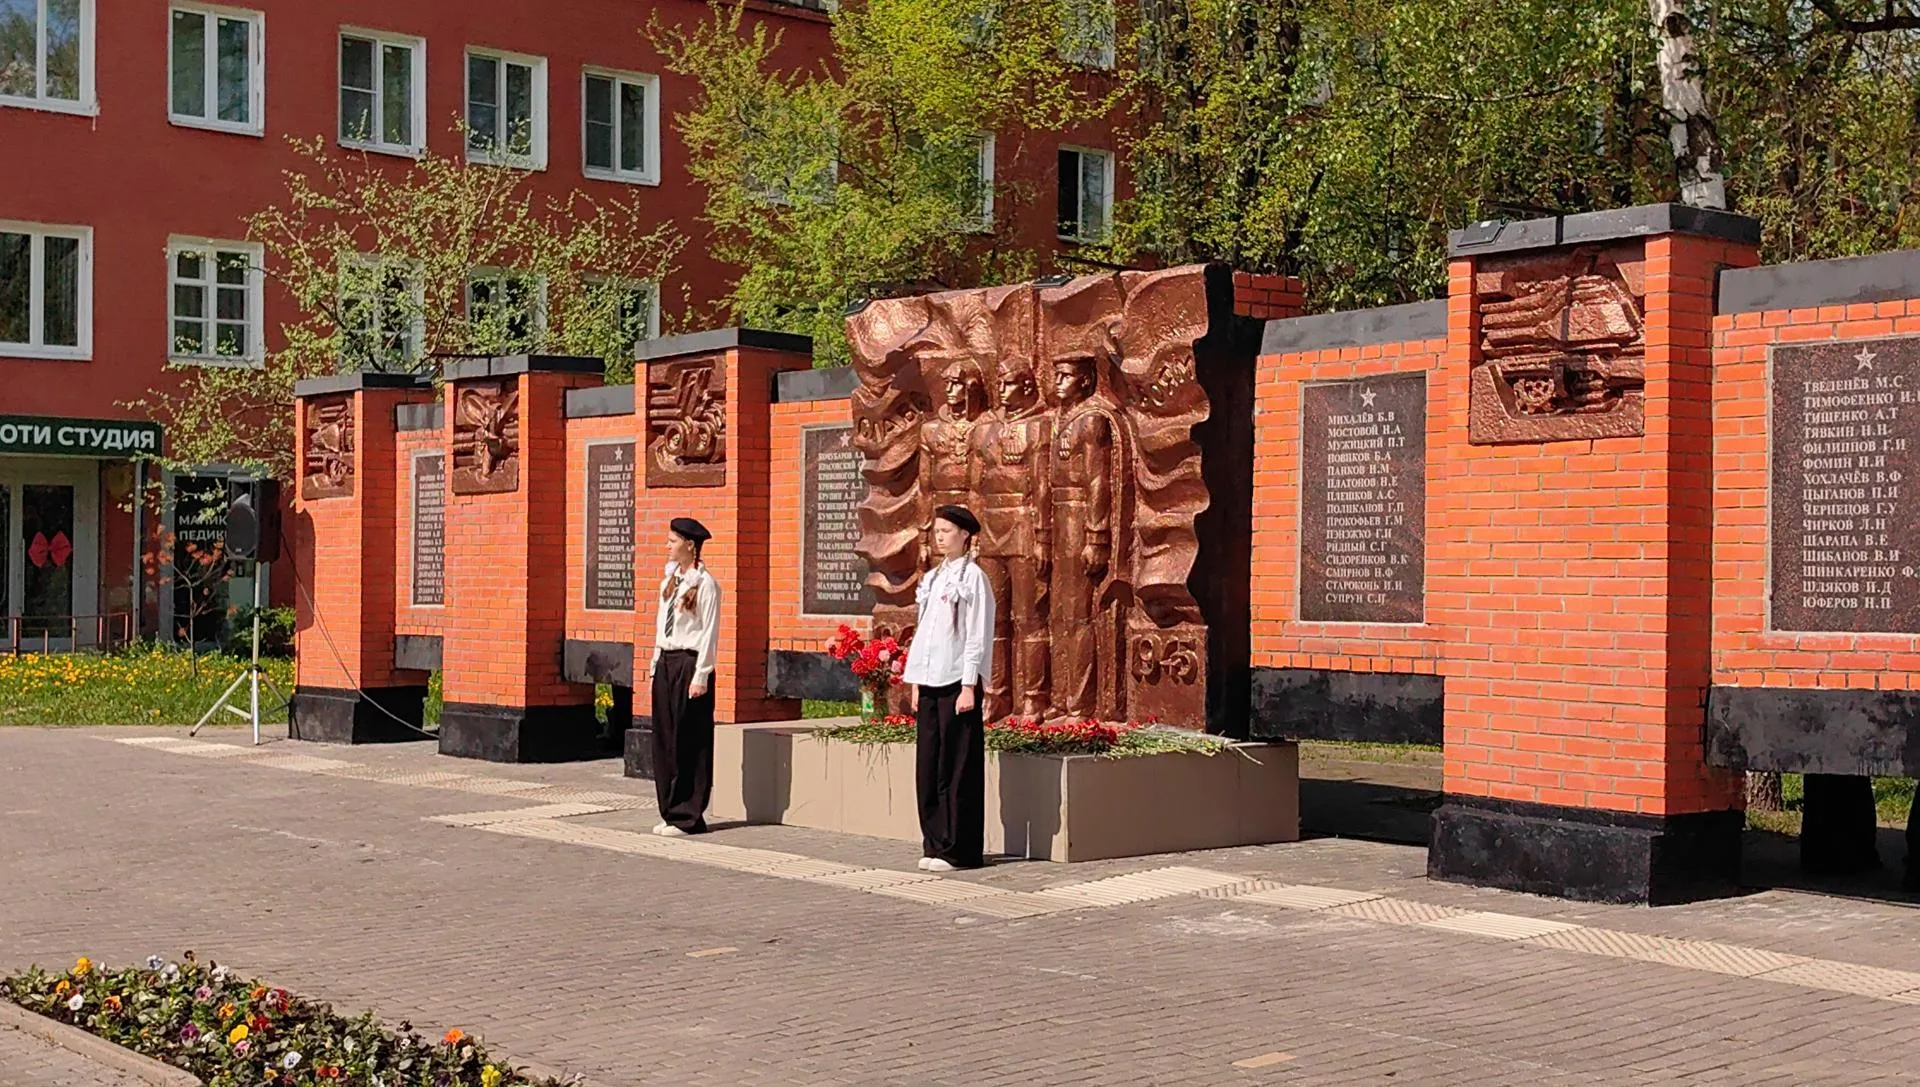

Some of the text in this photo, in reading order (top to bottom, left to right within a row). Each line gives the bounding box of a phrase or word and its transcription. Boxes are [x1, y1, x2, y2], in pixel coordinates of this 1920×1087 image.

[1875, 375, 1904, 388] М.С
[1803, 393, 1893, 408] ТИМОФЕЕНКО
[1377, 412, 1394, 422] Б.В
[1803, 408, 1899, 425] ТИЩЕНКО А.Т
[0, 424, 154, 450] ОТИ СТУДИЯ
[1328, 424, 1378, 438] МОСТОВОЙ
[1803, 426, 1854, 439] ТЯВКИН
[1388, 437, 1405, 447] П.Т
[1803, 439, 1906, 454] ФИЛИППОВ Г.И
[1328, 451, 1391, 463] НОВИКОВ Б.А
[1803, 457, 1852, 469] ФОМИН
[1328, 466, 1365, 476] ПАНКОВ
[1328, 478, 1375, 489] ПЛАТОНОВ
[1803, 471, 1901, 485] ХОХЛАЧЁВ В.Ф
[1327, 490, 1396, 501] ПЛЕШКОВ А.С
[1803, 489, 1865, 501] ЦЫГАНОВ
[1388, 502, 1404, 512] Г.П
[1803, 503, 1898, 516] ЧЕРНЕЦОВ Г.У
[1327, 515, 1402, 526] ПРОКОФЬЕВ Г.М
[1803, 520, 1853, 530] ЧИРКОВ
[179, 530, 227, 541] ПЕДИК
[1803, 534, 1888, 546] ШАРАПА В.Е
[1370, 542, 1386, 552] С.Г
[1326, 555, 1408, 565] СИДОРЕНКОВ В.К
[1803, 550, 1900, 562] ШИБАНОВ В.И
[1326, 568, 1369, 577] СМИРНОВ
[1803, 565, 1920, 578] ШИНКАРЕНКО Ф.
[1803, 581, 1859, 593] ШЛЯКОВ
[1326, 593, 1362, 603] СУПРУН
[1803, 597, 1858, 609] ЮФЕРОВ
